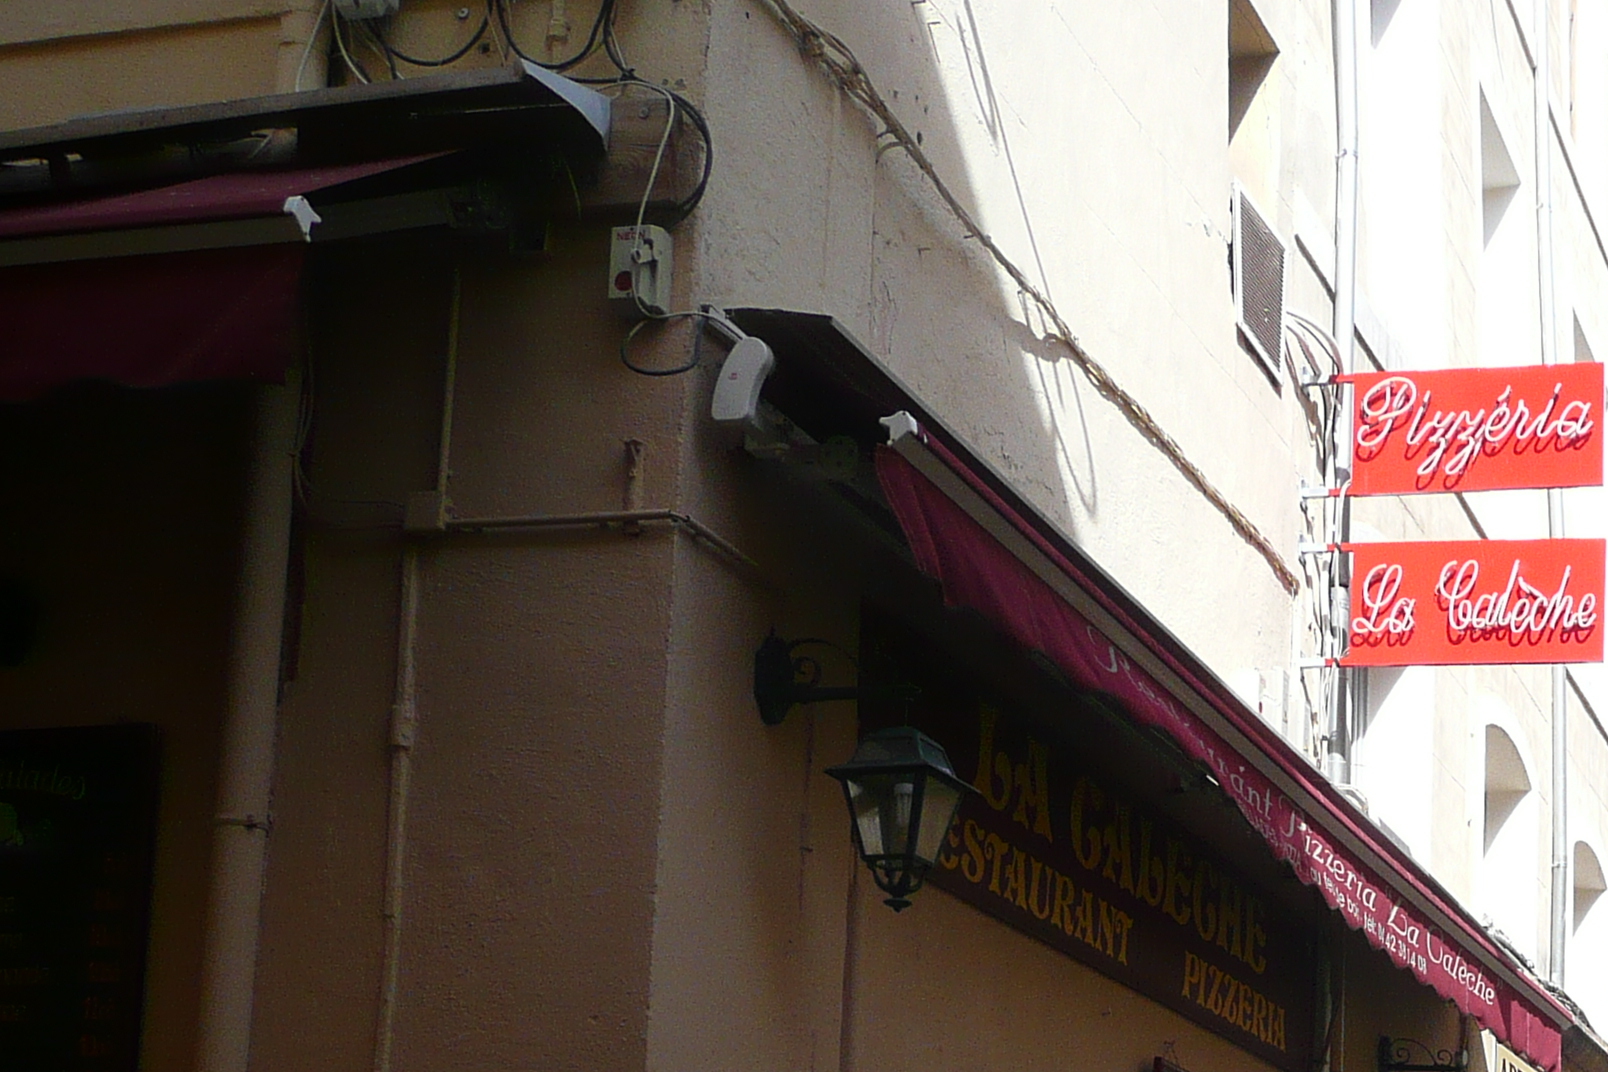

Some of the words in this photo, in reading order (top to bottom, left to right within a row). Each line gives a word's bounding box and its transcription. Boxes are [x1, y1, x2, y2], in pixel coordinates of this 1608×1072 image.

[1356, 376, 1595, 475] Pizzéria
[1352, 563, 1416, 634] La
[1437, 559, 1597, 634] Calèche
[974, 696, 1054, 844] LA
[1279, 794, 1376, 913] Pizzeria
[1387, 897, 1419, 948] La
[1427, 925, 1496, 1006] Calèche
[1181, 950, 1287, 1053] PIZZERIA
